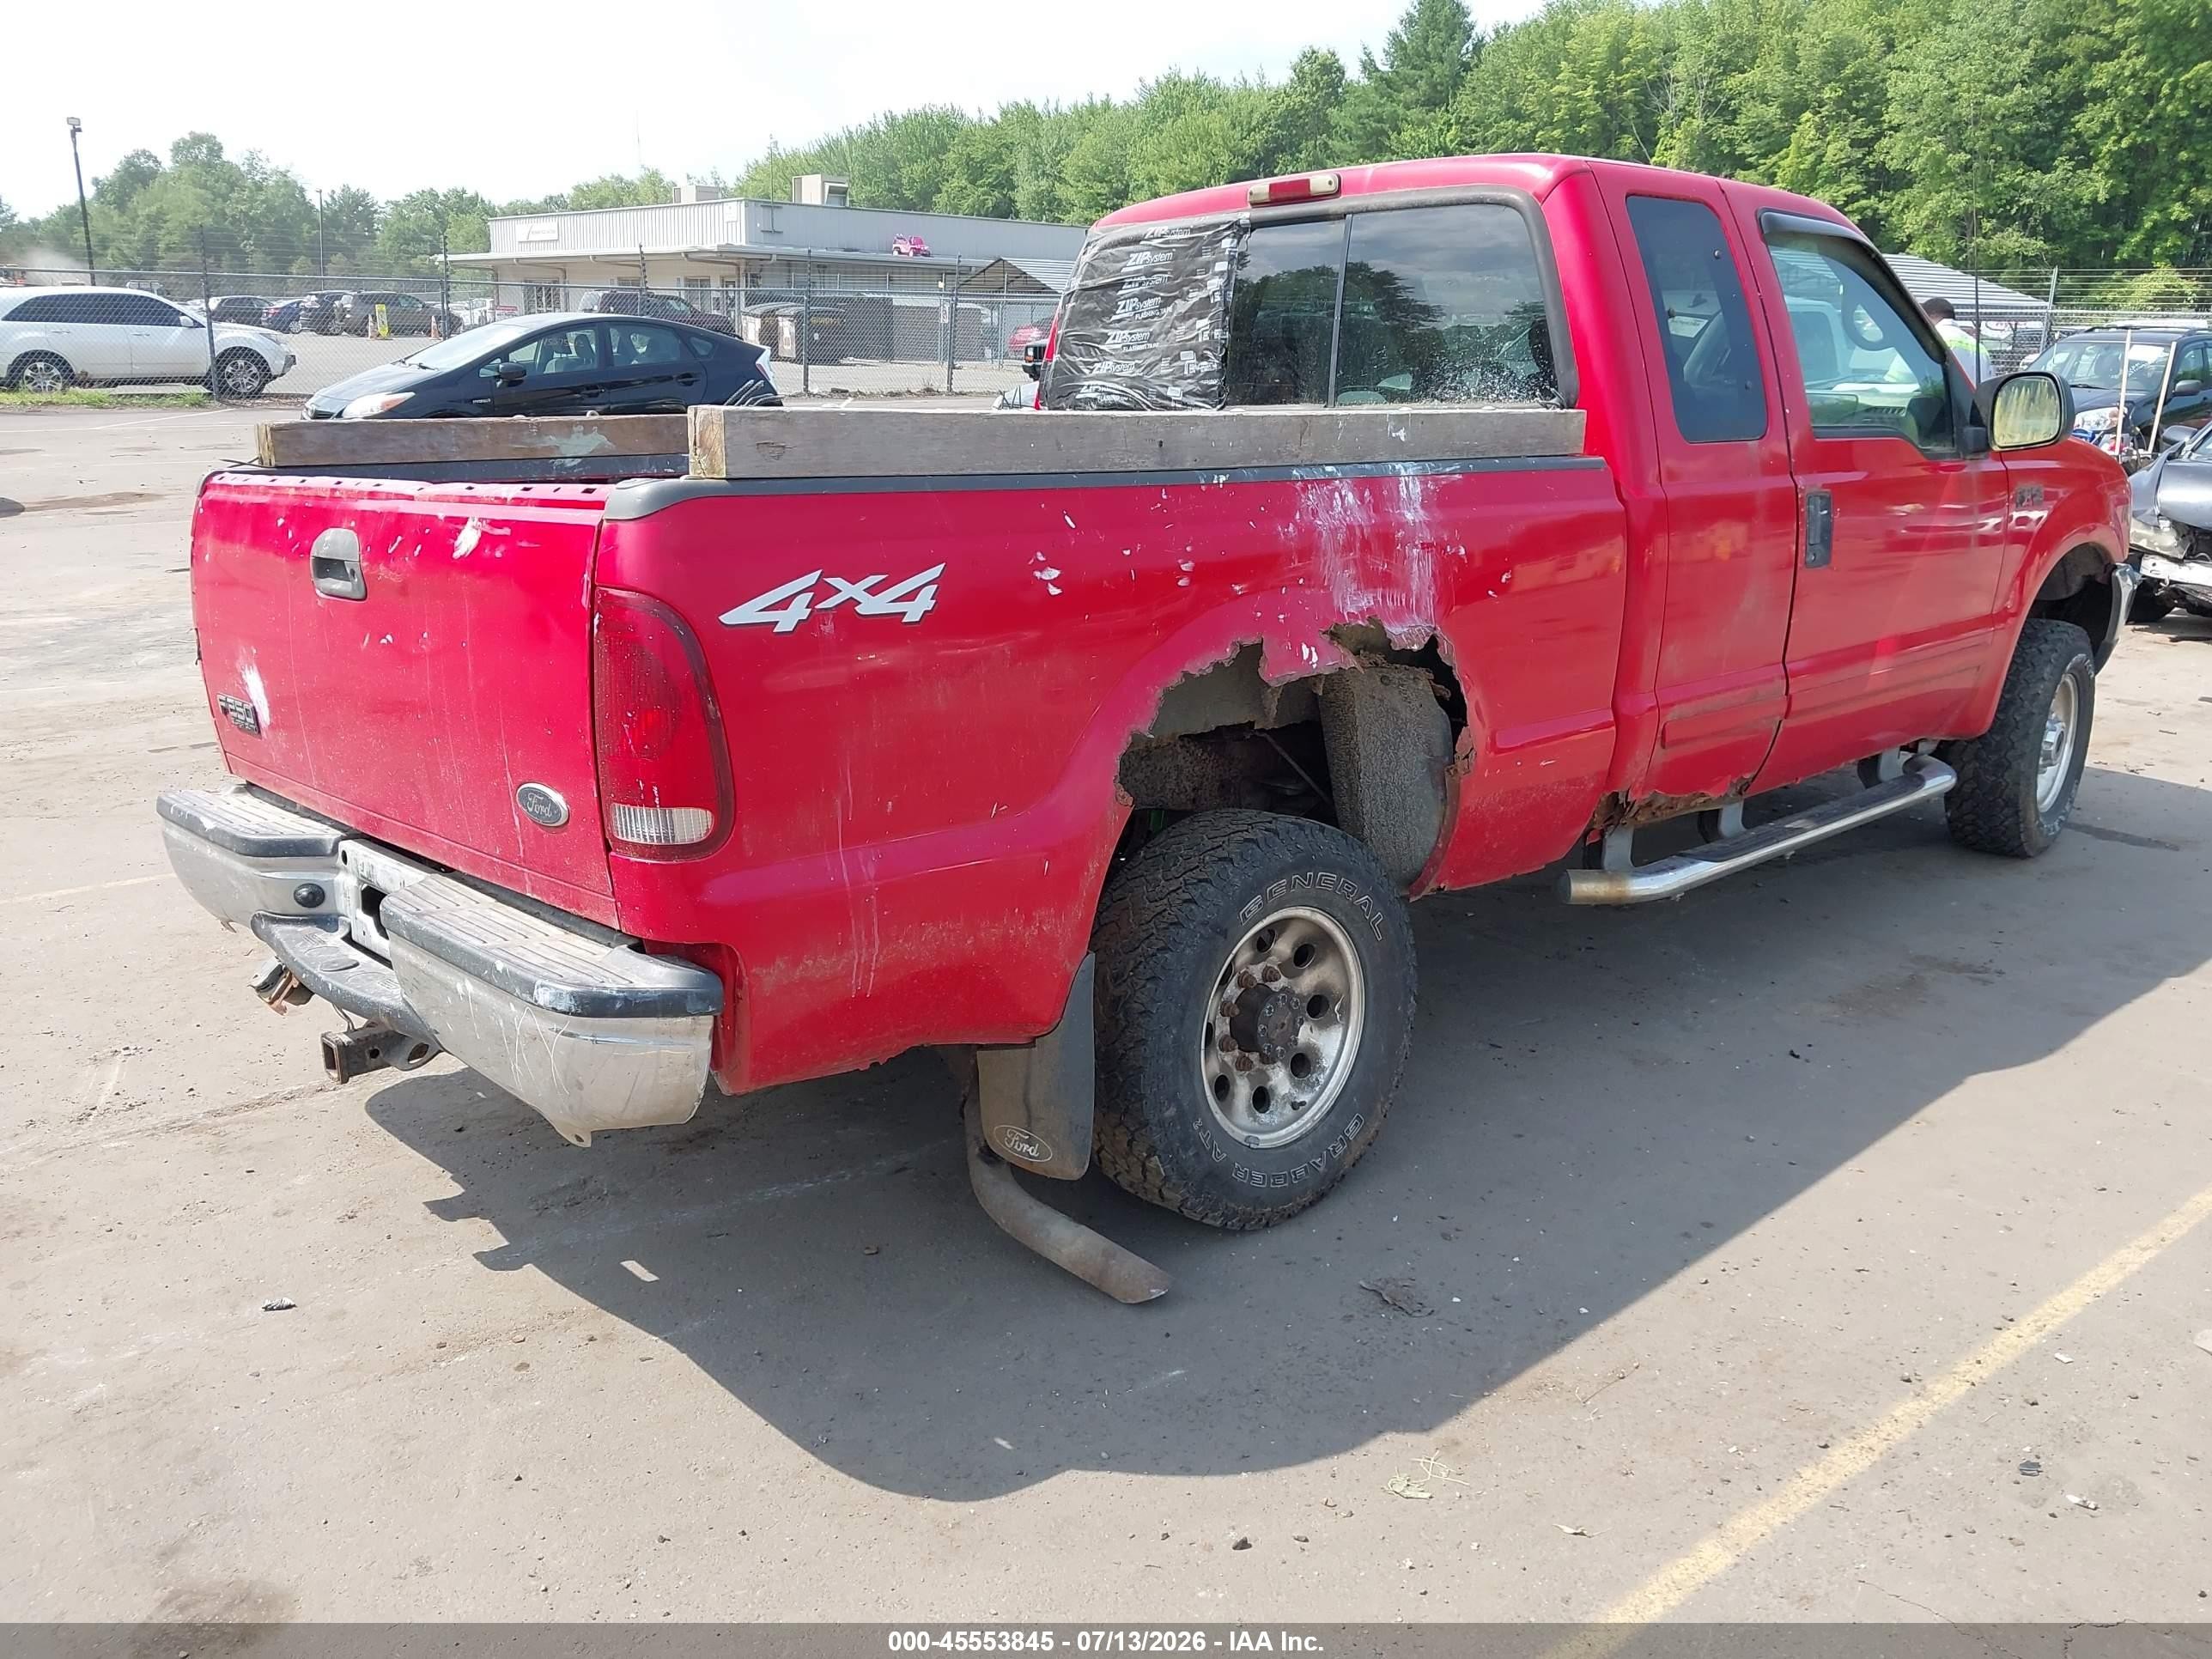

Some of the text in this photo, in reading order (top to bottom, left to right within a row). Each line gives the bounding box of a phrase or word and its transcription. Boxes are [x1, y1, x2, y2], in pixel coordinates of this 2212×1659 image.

[526, 792, 553, 817] Ford
[1239, 872, 1383, 941] GENERAL
[1004, 1128, 1040, 1157] Ford
[1231, 1113, 1364, 1188] GRABBER
